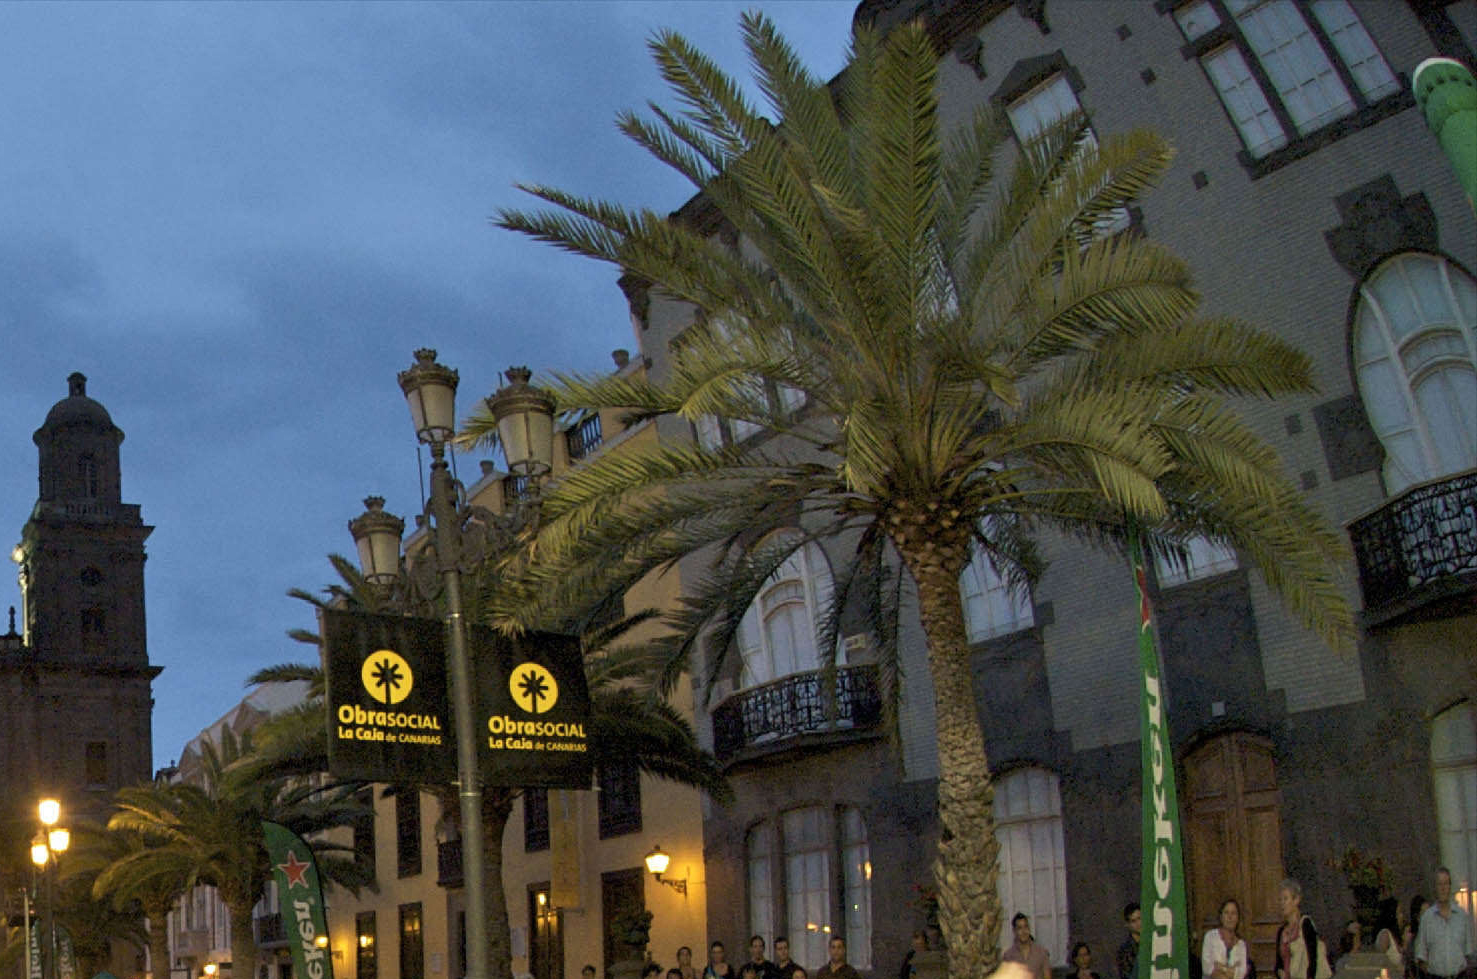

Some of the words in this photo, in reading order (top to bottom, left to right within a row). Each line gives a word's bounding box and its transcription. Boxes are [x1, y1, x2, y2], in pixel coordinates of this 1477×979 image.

[338, 727, 353, 740] La
[355, 727, 385, 742] Caja
[385, 733, 397, 743] de
[399, 734, 442, 745] CANARIAS
[489, 736, 504, 749] La
[506, 736, 533, 751] Caja
[535, 742, 545, 751] de
[546, 742, 587, 752] CANARIAS
